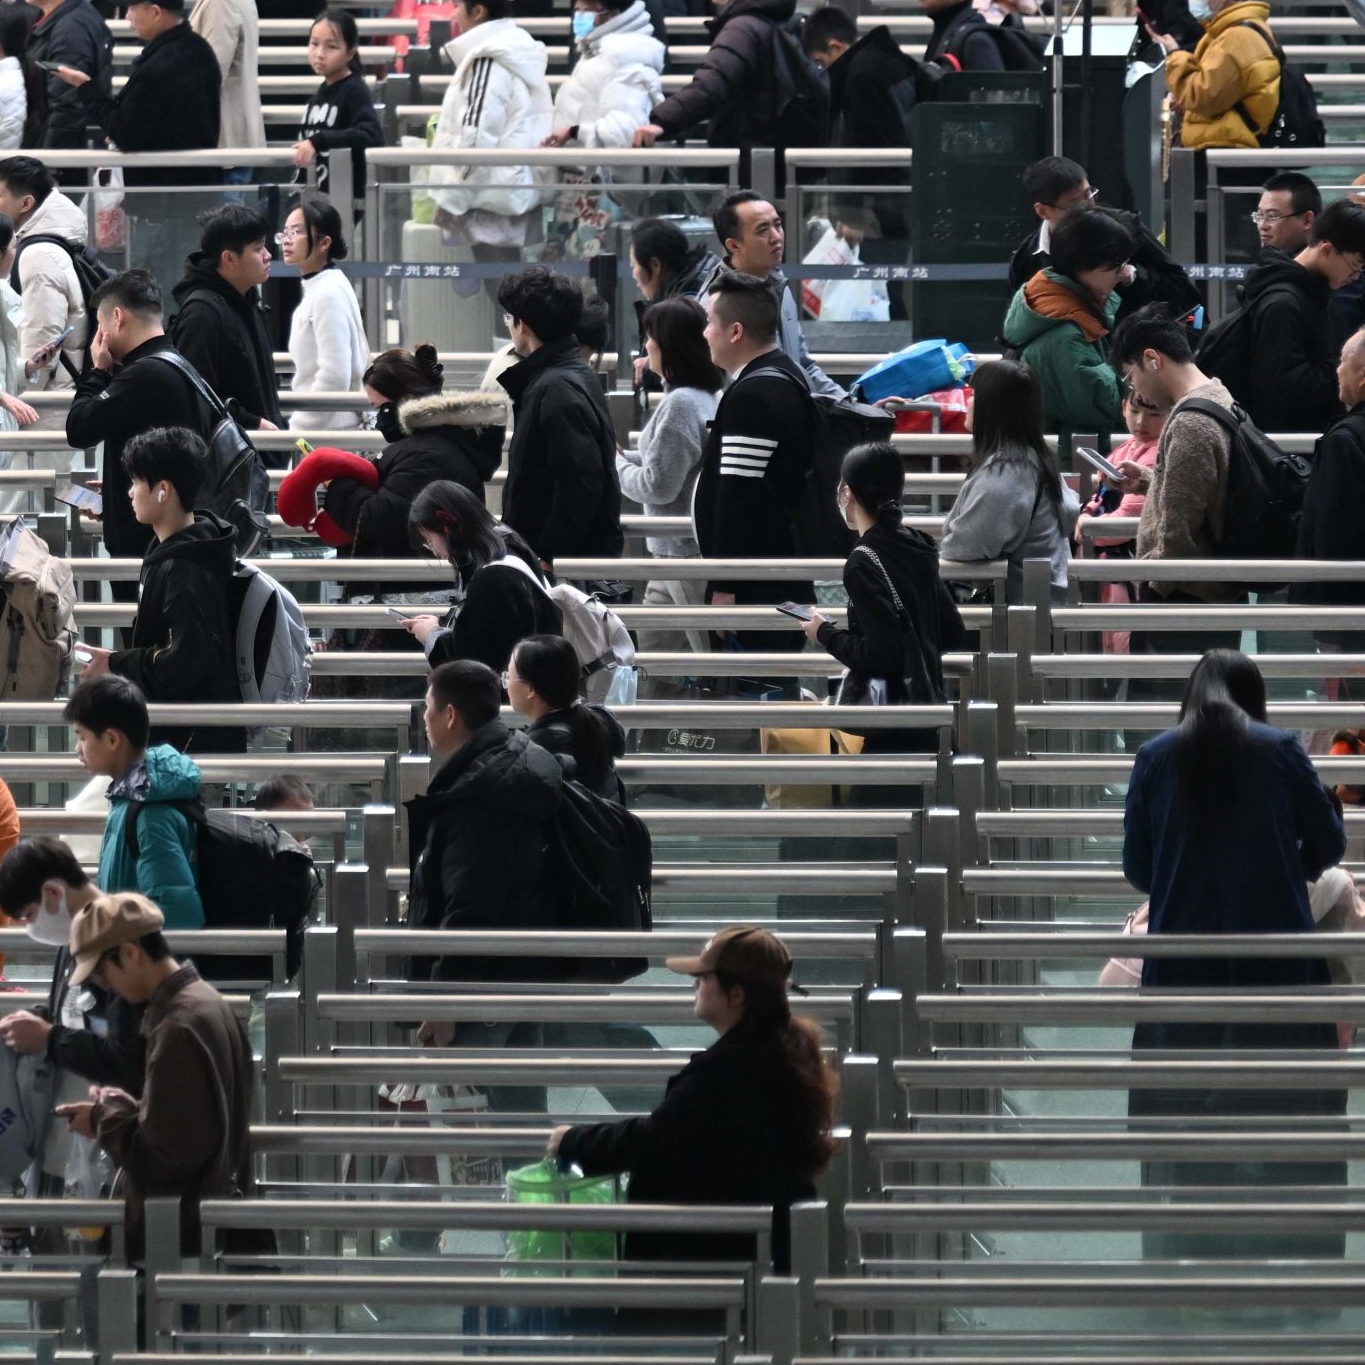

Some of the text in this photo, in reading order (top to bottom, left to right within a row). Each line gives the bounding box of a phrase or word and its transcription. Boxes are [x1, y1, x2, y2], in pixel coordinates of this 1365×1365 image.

[385, 265, 461, 278] 广州南站
[853, 266, 929, 279] 广州南站
[1183, 266, 1245, 278] 州南站
